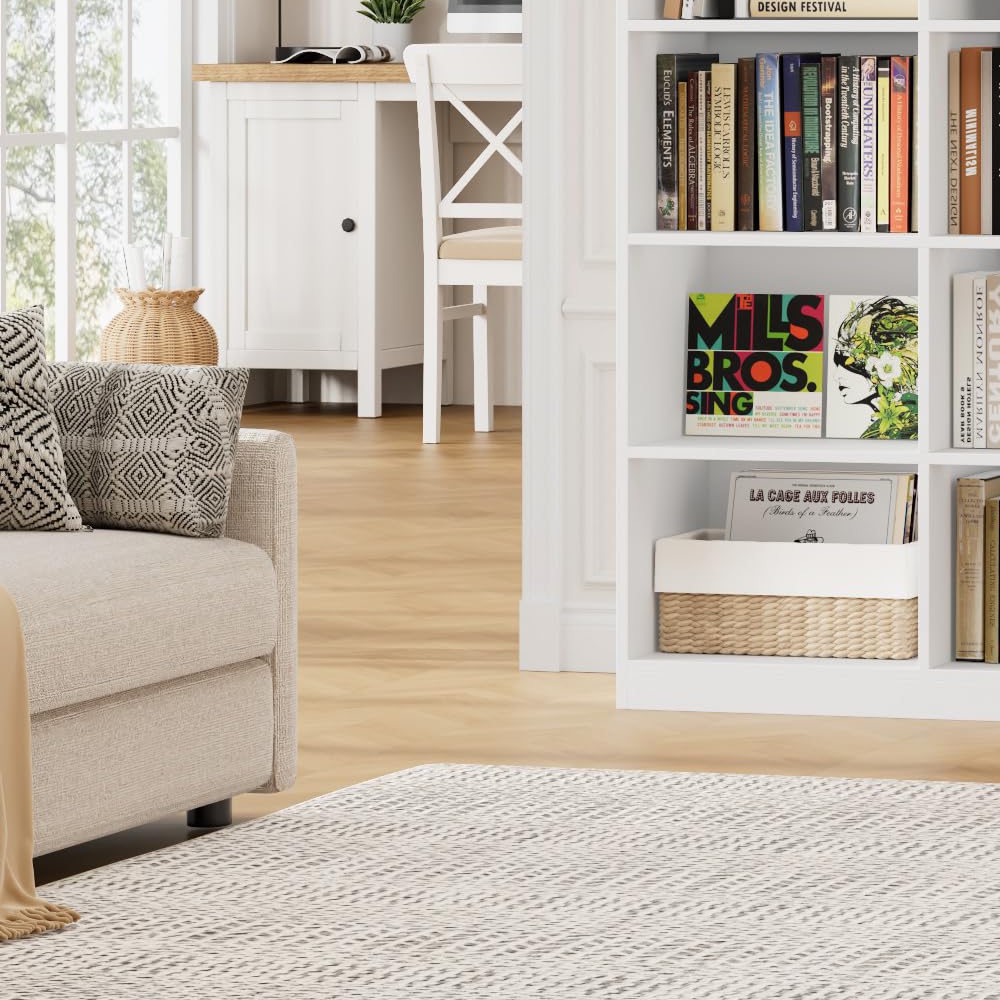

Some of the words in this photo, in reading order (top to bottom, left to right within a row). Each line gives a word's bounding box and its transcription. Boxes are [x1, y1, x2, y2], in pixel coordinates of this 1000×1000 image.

[663, 110, 674, 167] ELEMENTS
[823, 97, 832, 162] Bootstrapping
[687, 352, 817, 392] BROS.
[686, 392, 753, 415] SING
[750, 489, 765, 502] LA
[767, 489, 800, 503] CAGE
[803, 490, 828, 504] AUX
[832, 491, 875, 504] FOLLES
